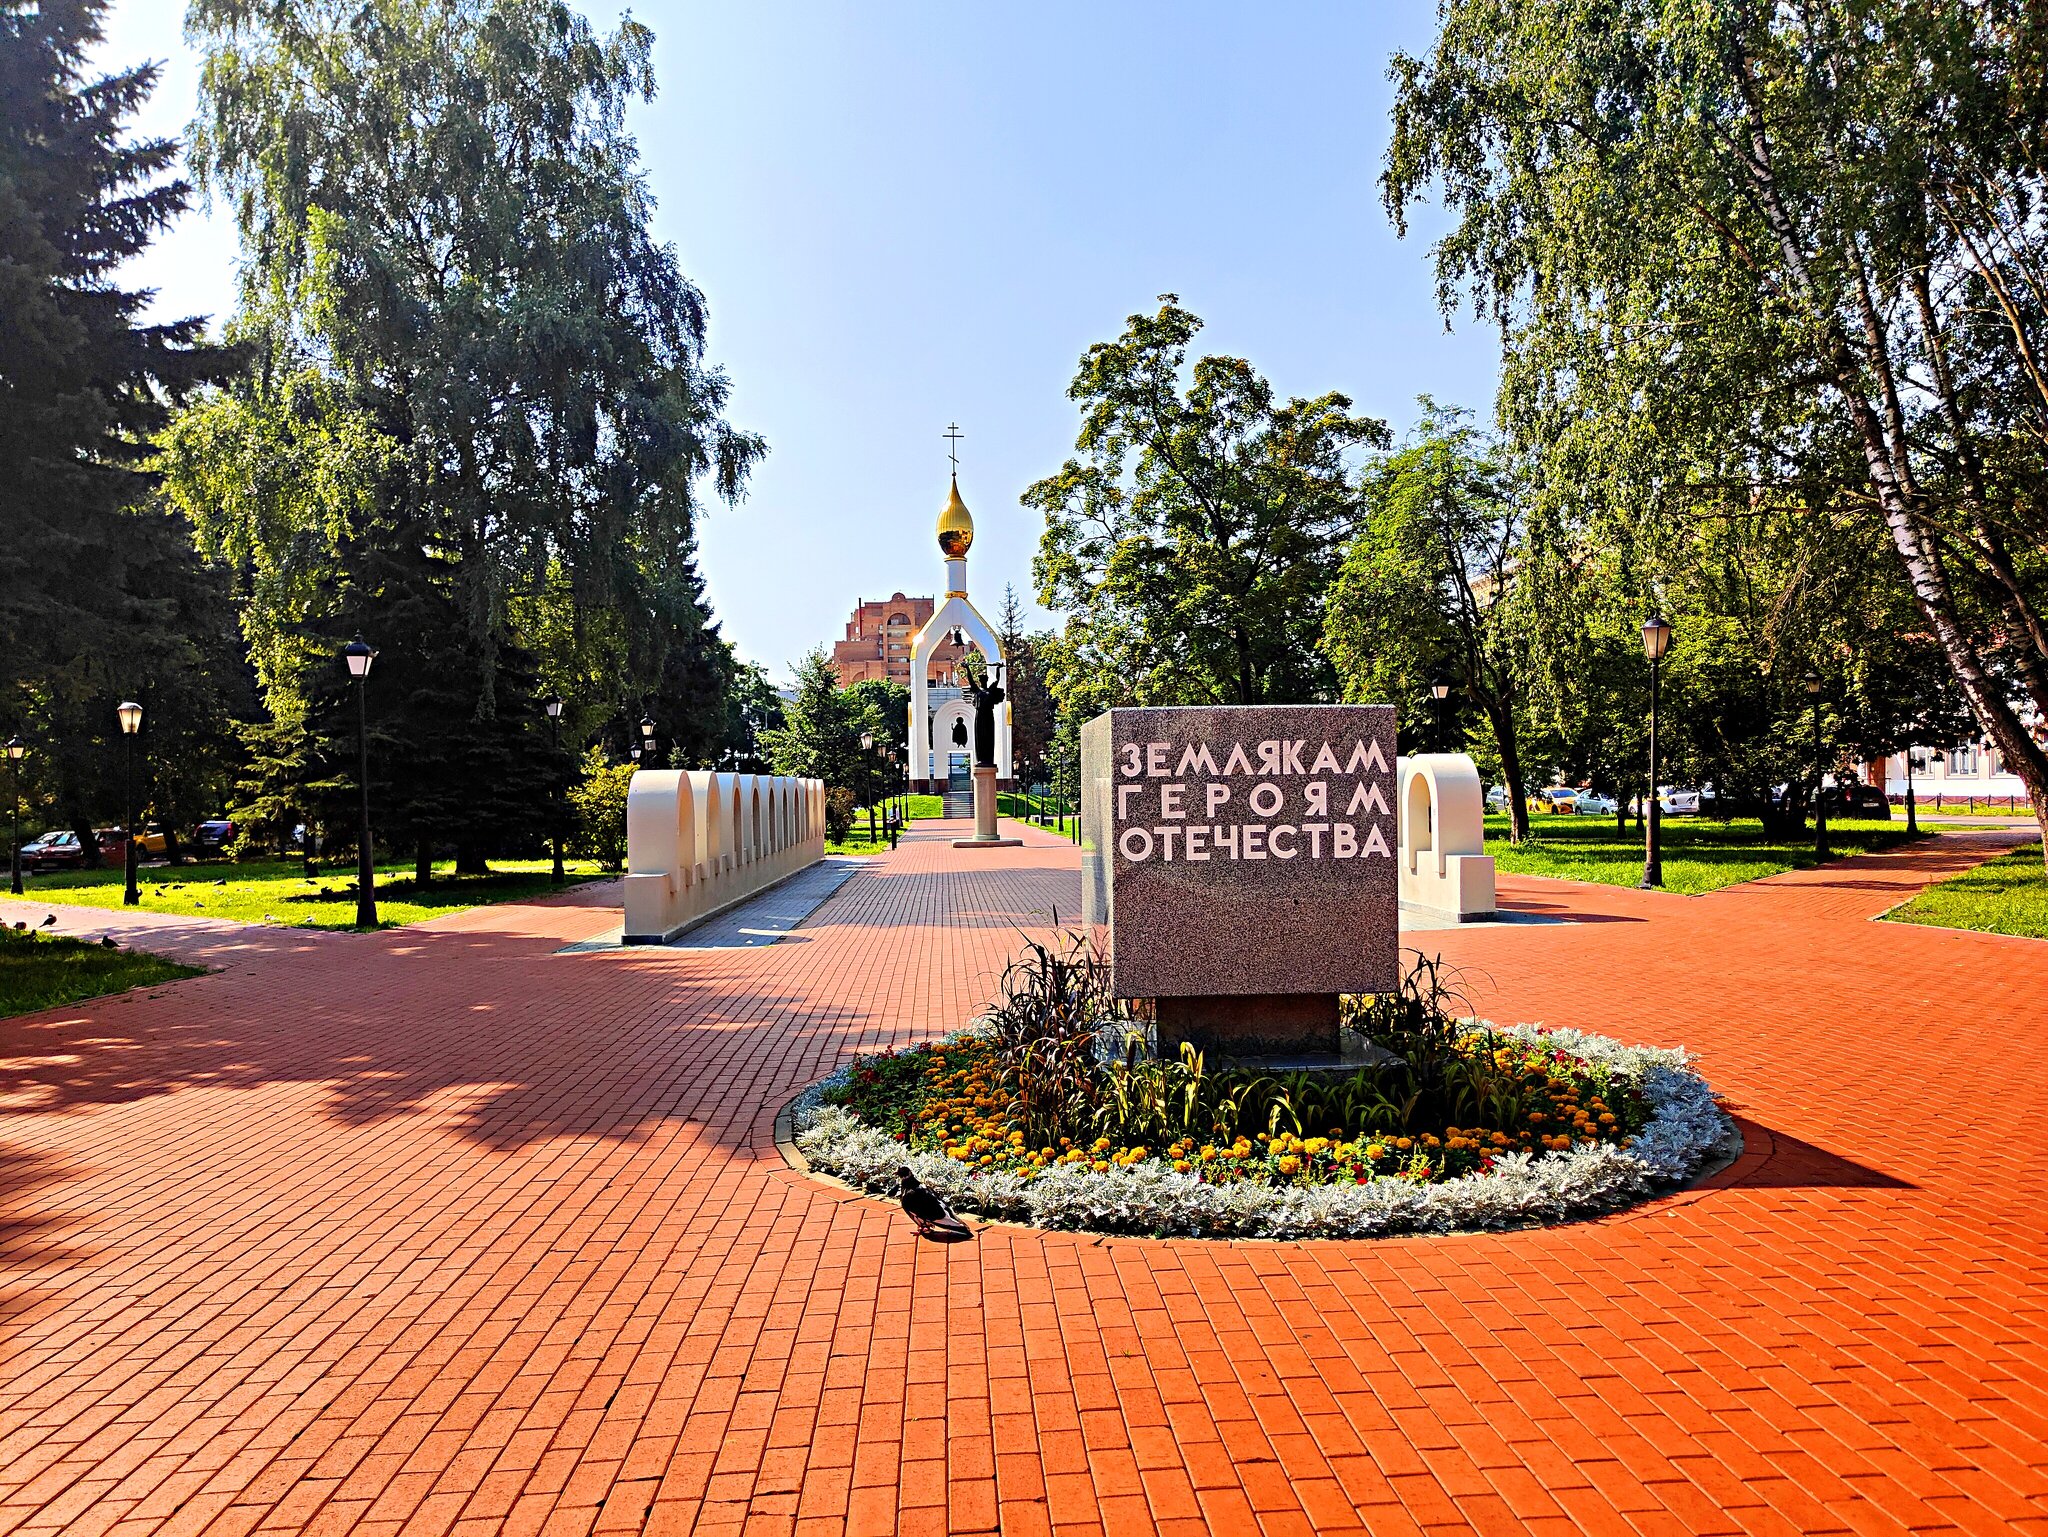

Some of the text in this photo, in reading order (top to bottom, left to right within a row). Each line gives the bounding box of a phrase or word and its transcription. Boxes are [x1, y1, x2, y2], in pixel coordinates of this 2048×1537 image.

[1120, 738, 1390, 777] ЗЕМЛЯКАМ
[1118, 781, 1391, 820] ГЕРОЯМ
[1118, 823, 1392, 862] ОТЕЧЕСТВА
